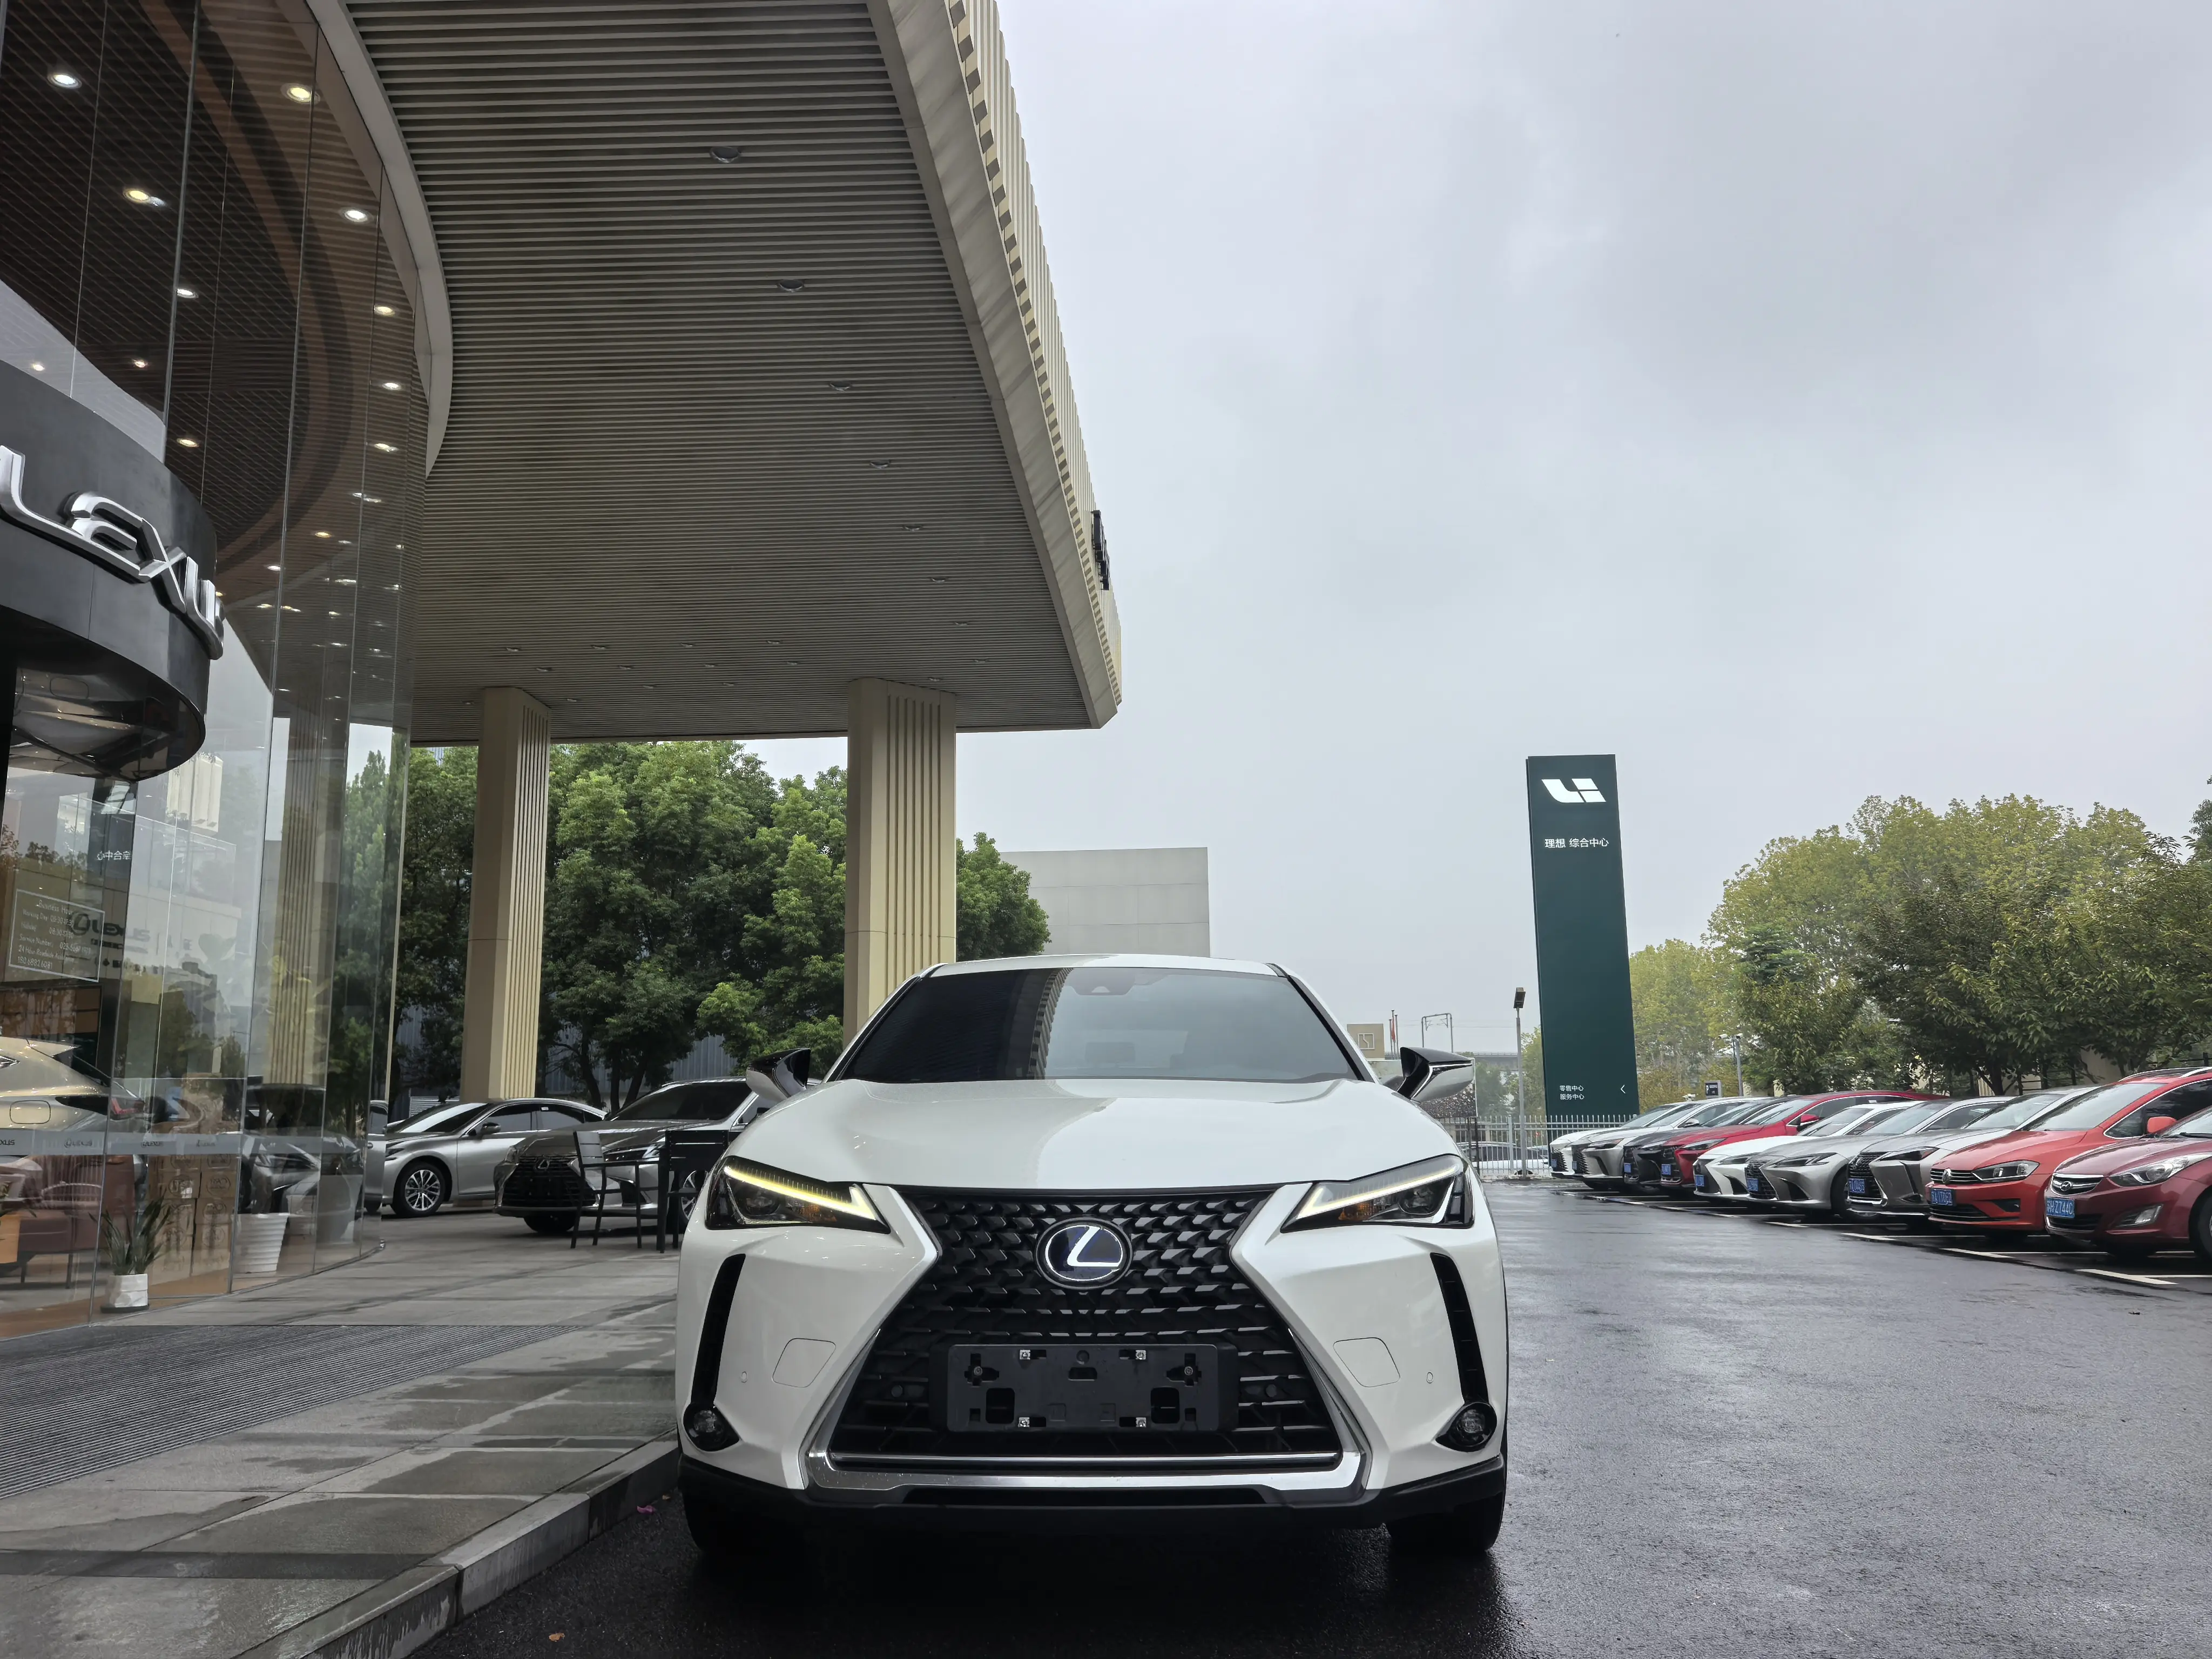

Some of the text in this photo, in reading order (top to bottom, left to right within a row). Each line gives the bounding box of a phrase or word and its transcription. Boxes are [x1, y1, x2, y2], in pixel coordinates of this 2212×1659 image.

[0, 445, 224, 660] LEXU
[1545, 838, 1609, 848] 理想 综合中心
